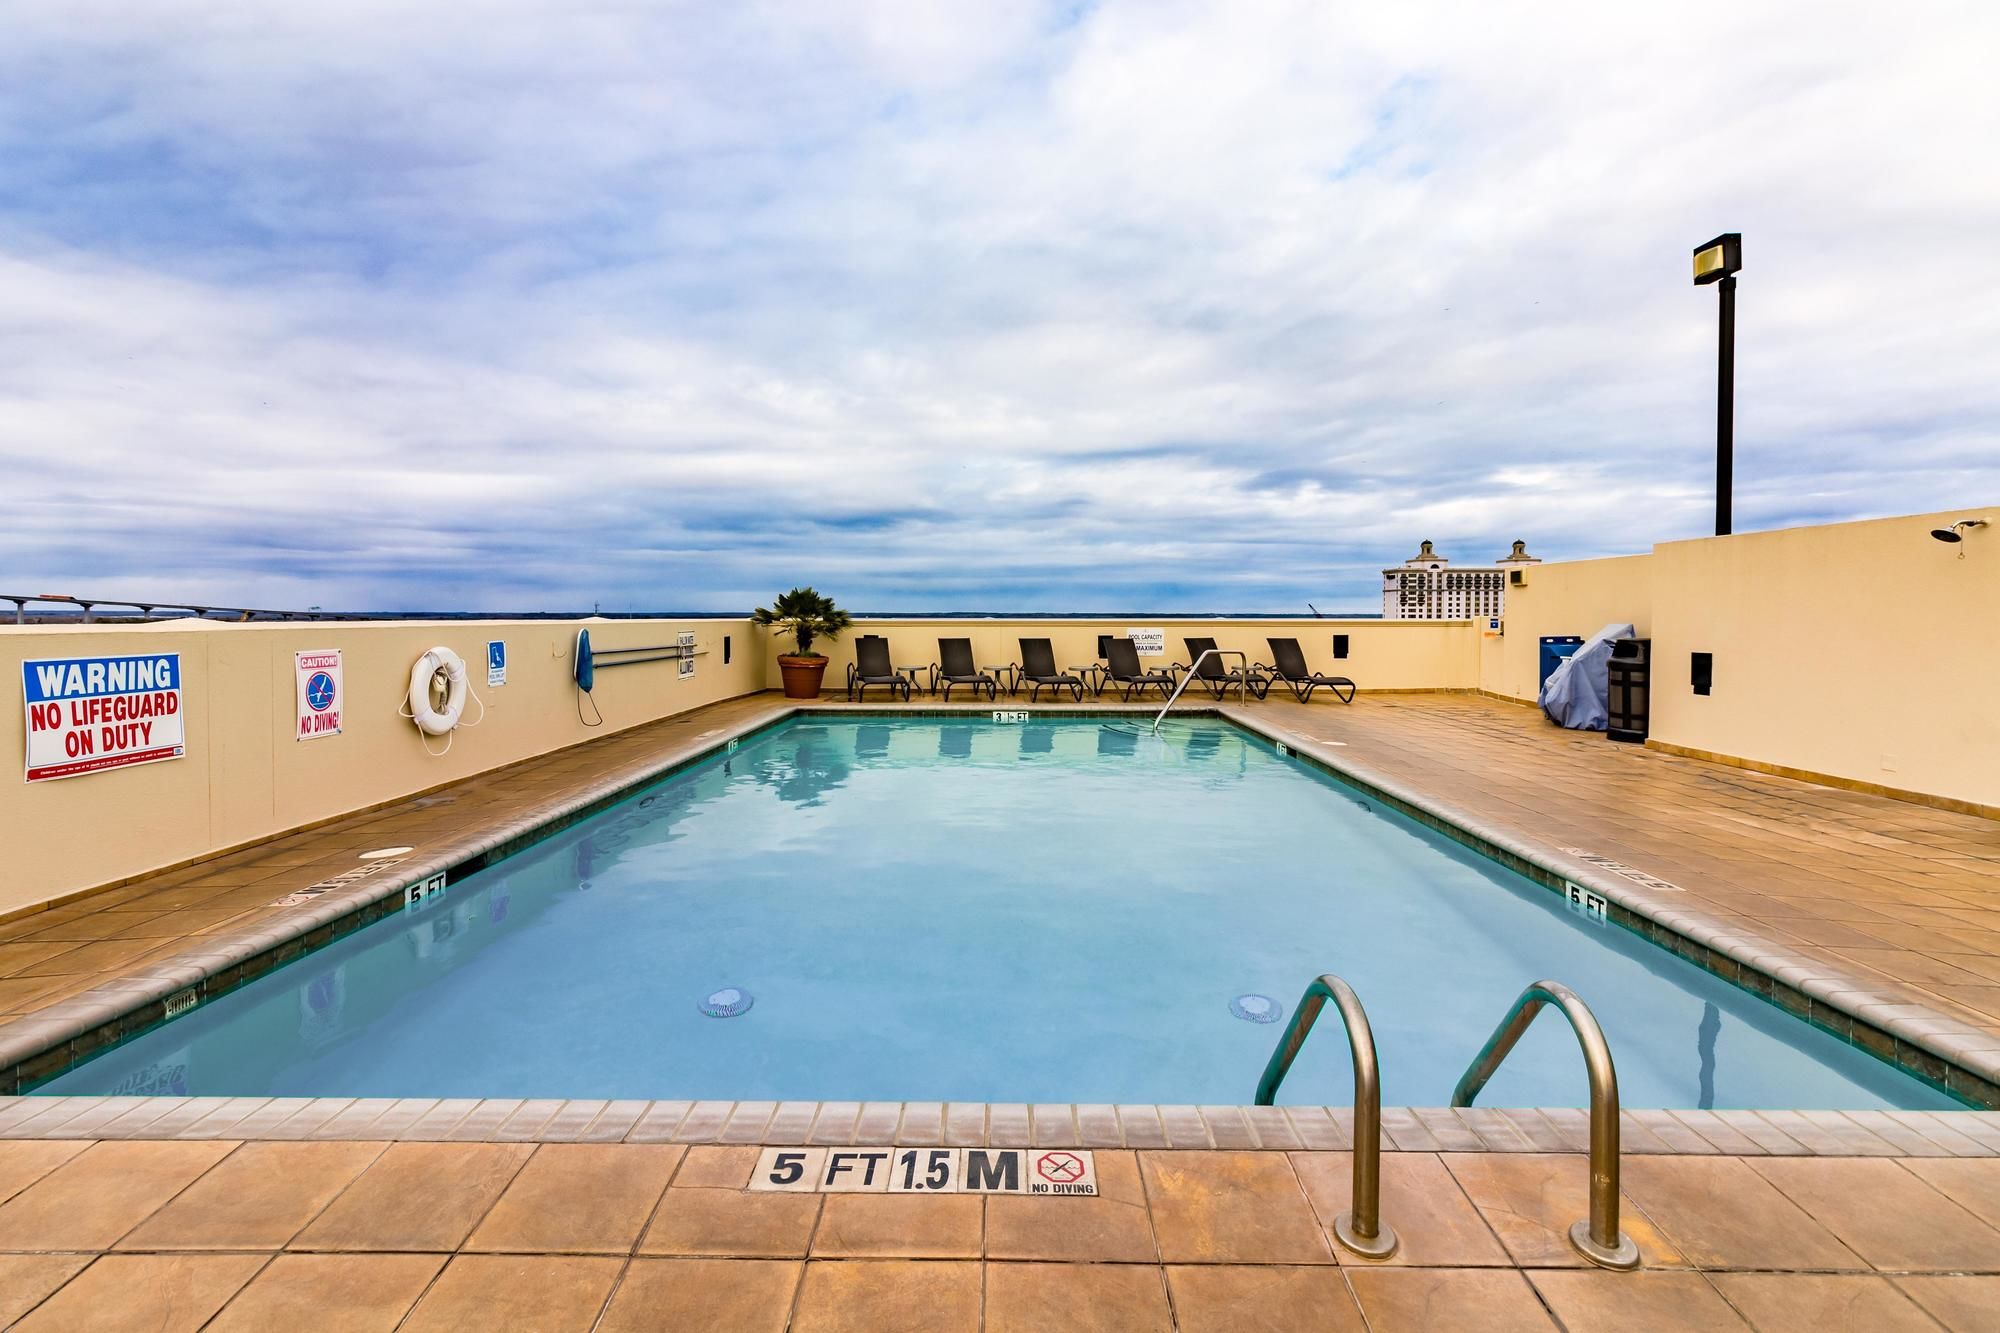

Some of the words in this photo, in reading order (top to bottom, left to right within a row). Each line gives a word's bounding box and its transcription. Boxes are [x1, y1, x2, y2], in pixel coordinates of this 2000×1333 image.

[301, 656, 337, 668] CAUTION!
[36, 658, 171, 698] WARNING
[30, 702, 61, 732] NO
[71, 691, 178, 727] LIFEGUARD
[301, 715, 311, 735] NO
[314, 711, 340, 733] DIVING!
[996, 712, 1002, 722] 3
[65, 729, 94, 758] ON
[102, 721, 153, 752] DUTY
[411, 885, 421, 904] 5
[428, 874, 444, 896] FT
[1571, 885, 1580, 904] 5
[1587, 894, 1605, 915] FT
[769, 1153, 807, 1185] 5
[825, 1153, 888, 1186] FT
[900, 1150, 950, 1190] 1.5
[966, 1150, 1019, 1191] M
[1032, 1183, 1048, 1193] NO
[1053, 1183, 1094, 1194] DIVING
